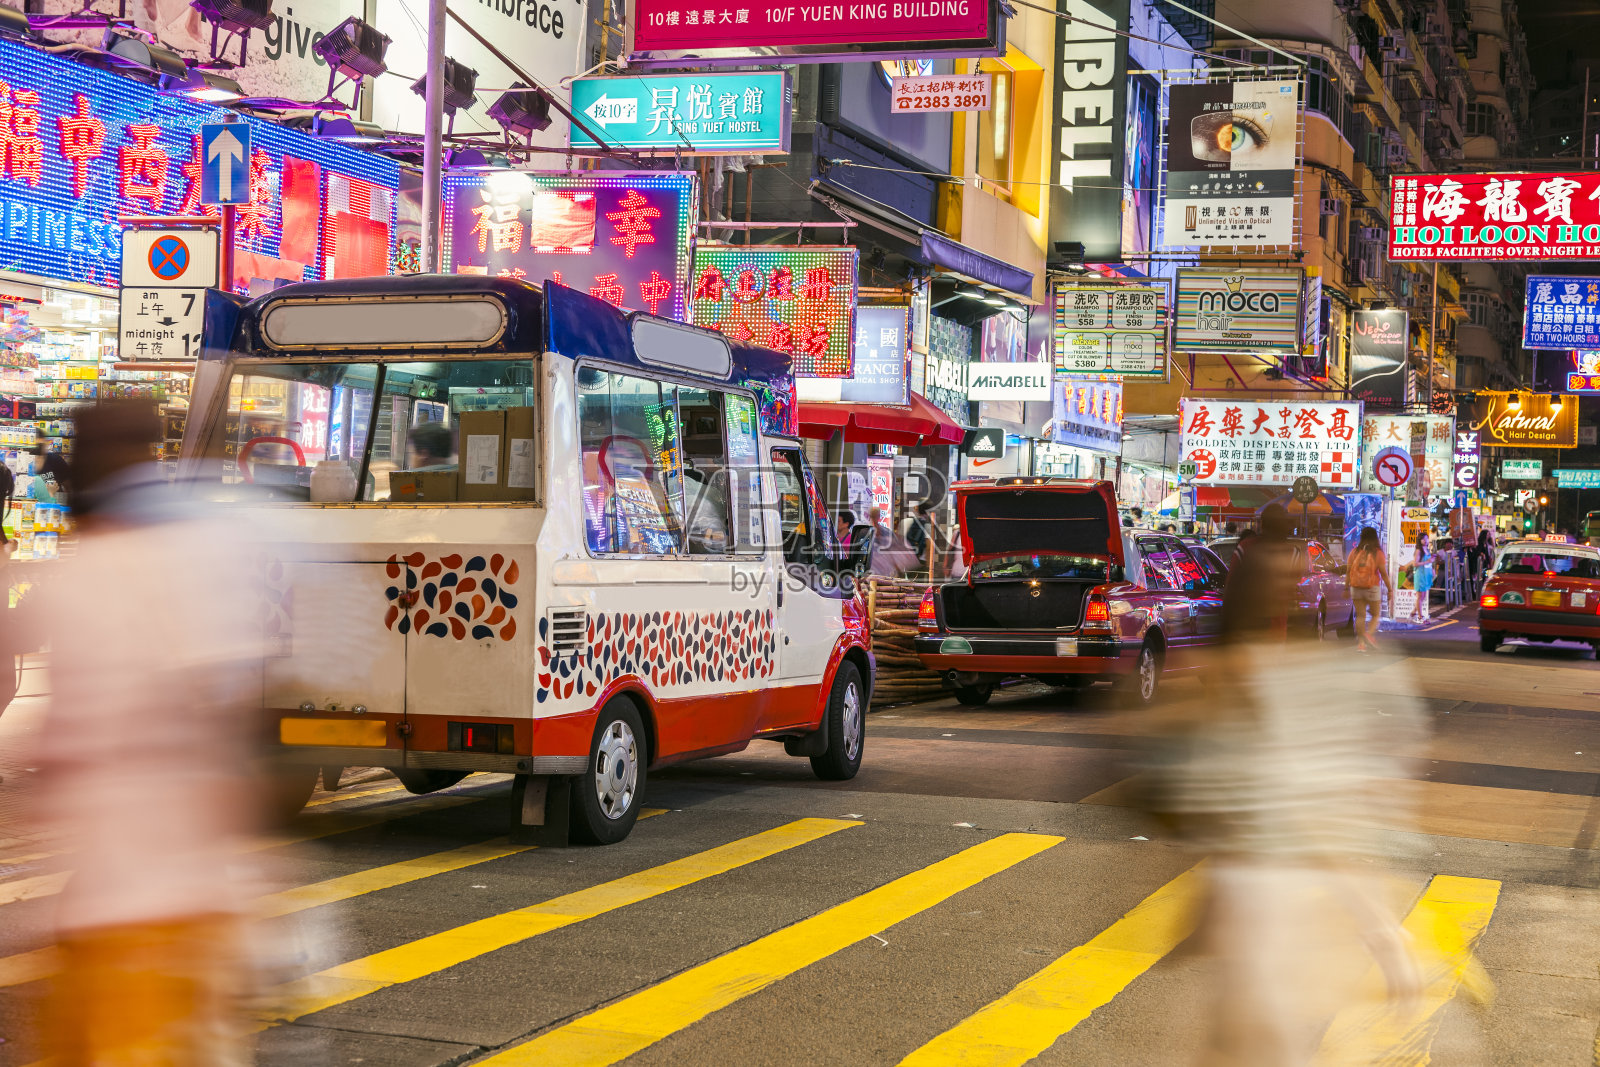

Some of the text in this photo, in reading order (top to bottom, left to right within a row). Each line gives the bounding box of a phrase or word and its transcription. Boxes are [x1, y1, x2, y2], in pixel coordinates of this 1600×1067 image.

[648, 1, 969, 26] 10樓 遠景大廈 10/F YUEN KING BUILDING
[914, 94, 987, 109] 2383 3891
[702, 120, 725, 133] YUET
[729, 120, 762, 133] HOSTEL
[1249, 217, 1272, 225] Optical
[1393, 225, 1455, 245] HOI
[1459, 224, 1550, 245] LOON
[1392, 247, 1435, 258] HOTEL
[1436, 246, 1505, 257] FACILITEIS
[1506, 246, 1540, 257] OVER
[1542, 246, 1584, 256] NIGHT
[142, 291, 197, 317] am 7
[1074, 293, 1099, 306] 洗吹
[1115, 293, 1154, 306] 洗剪吹
[1198, 291, 1280, 313] moca
[136, 302, 165, 317] 上午
[1532, 304, 1596, 314] REGENT
[1078, 318, 1094, 326] $58
[1126, 319, 1143, 327] $98
[1197, 312, 1233, 331] hair
[125, 329, 175, 341] midnight
[1546, 333, 1563, 342] TWO
[1563, 334, 1586, 343] HOURS
[136, 341, 164, 357] 午夜
[853, 363, 900, 375] RANCE
[1074, 360, 1096, 368] $380
[1474, 398, 1562, 441] Natural
[1509, 430, 1556, 440] Hair Design
[1187, 439, 1354, 450] GOLDEN DISPENSARY LTD.
[1219, 449, 1320, 462] 政府註冊 專營批發
[1179, 465, 1196, 475] 5M
